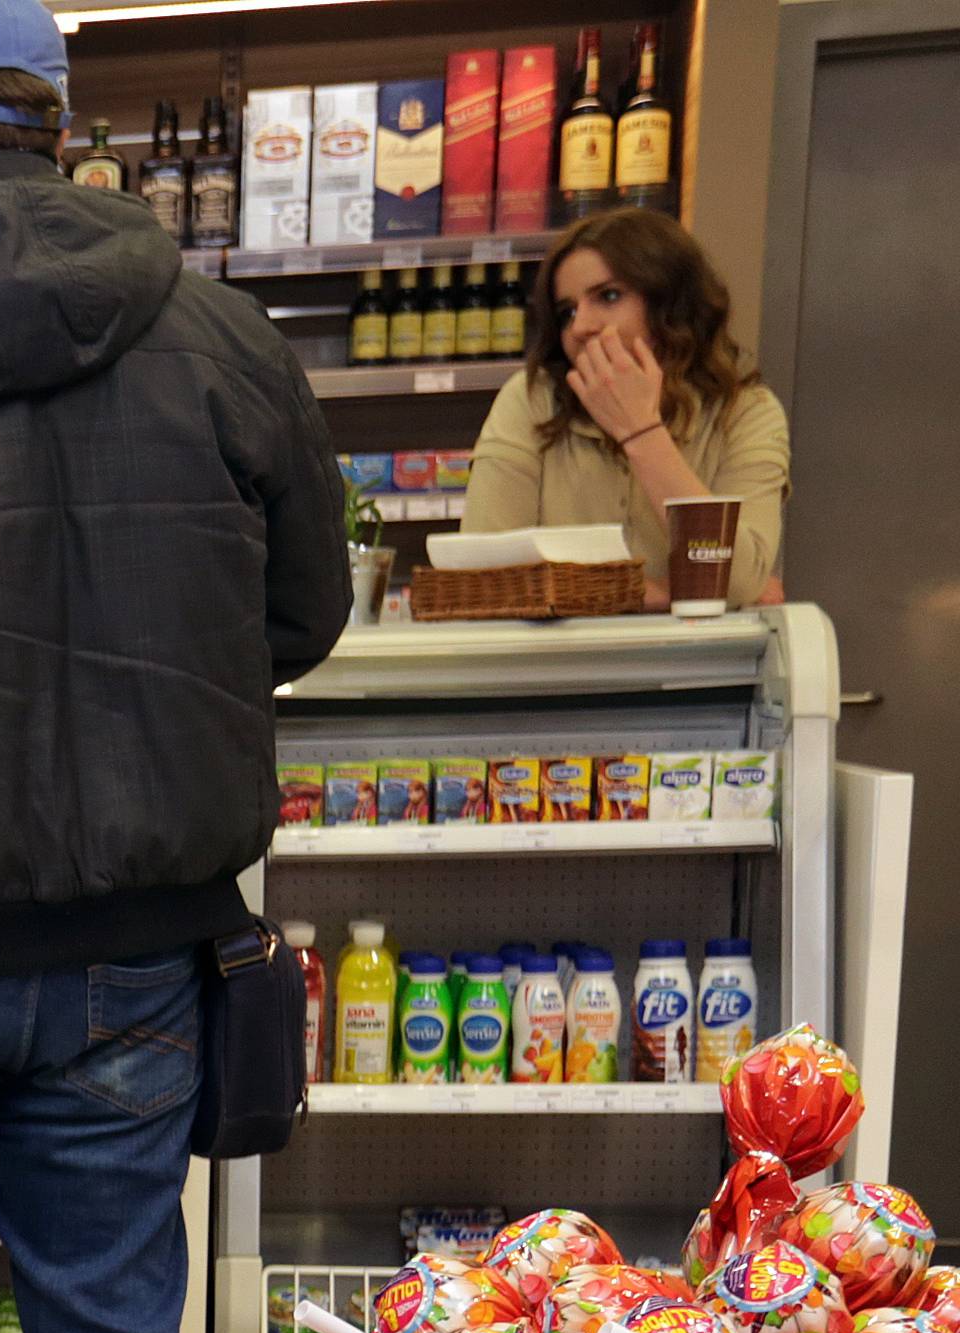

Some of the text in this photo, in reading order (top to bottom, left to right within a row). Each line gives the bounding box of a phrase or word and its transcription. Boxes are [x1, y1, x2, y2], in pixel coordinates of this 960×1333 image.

[663, 770, 700, 786] alpro
[727, 767, 764, 784] alpro
[643, 991, 679, 1024] fit
[705, 991, 741, 1023] fit
